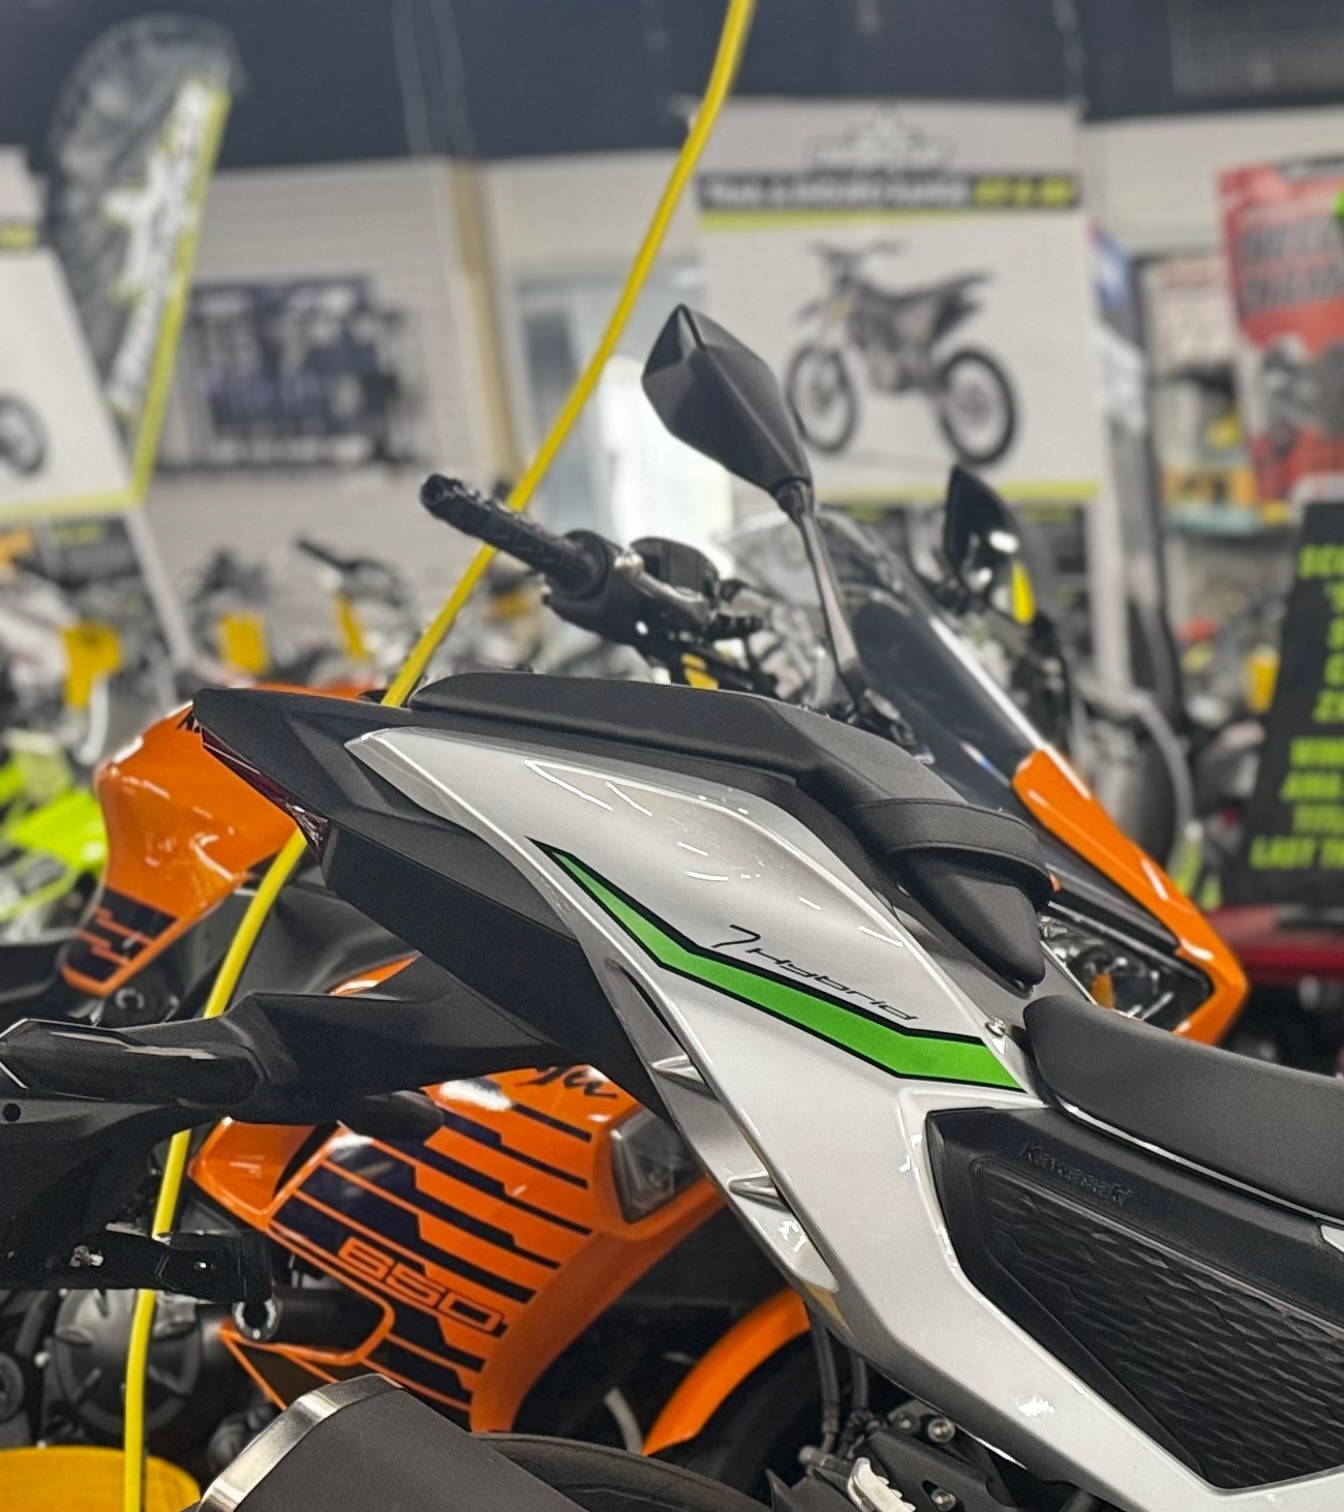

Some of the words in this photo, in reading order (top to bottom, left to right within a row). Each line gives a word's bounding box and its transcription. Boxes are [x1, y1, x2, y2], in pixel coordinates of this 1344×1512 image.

[711, 924, 761, 948] 7
[745, 947, 919, 1020] Hybrid
[337, 1236, 506, 1334] 650
